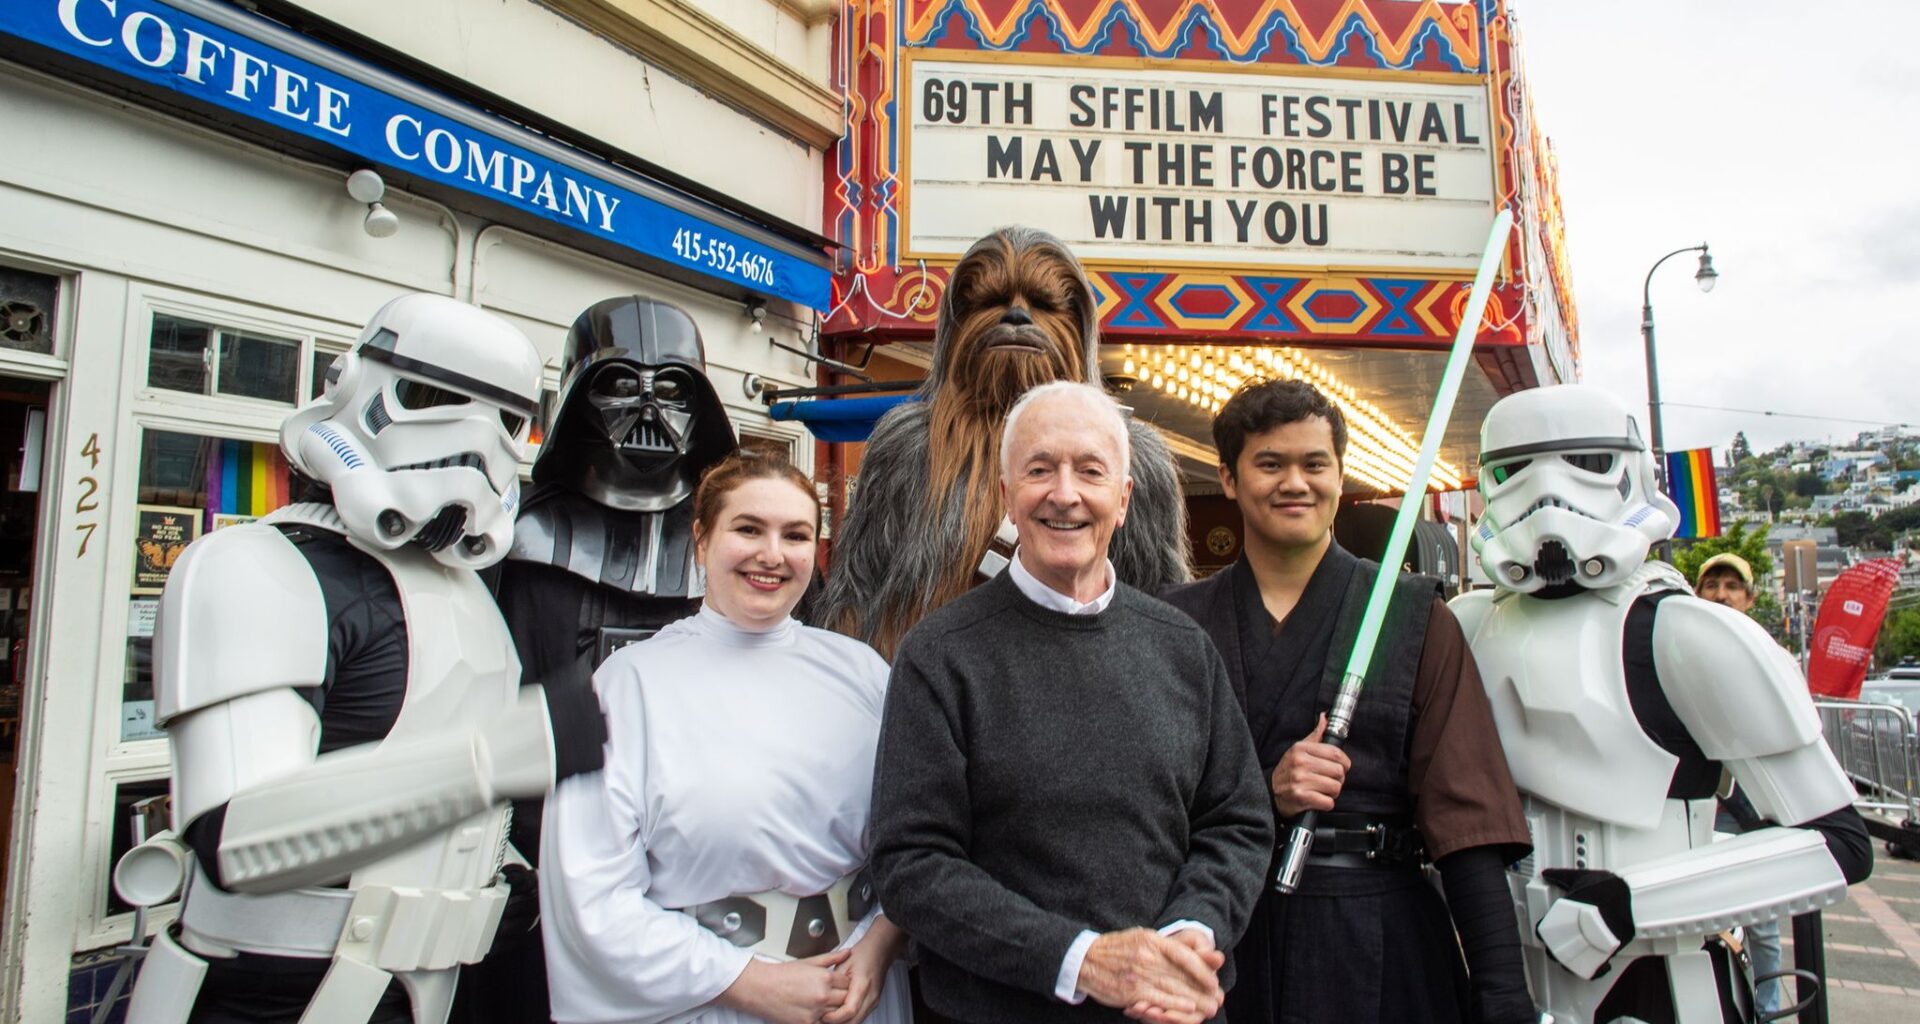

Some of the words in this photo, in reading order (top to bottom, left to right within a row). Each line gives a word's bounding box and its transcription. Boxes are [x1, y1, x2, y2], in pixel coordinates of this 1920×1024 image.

[58, 0, 352, 137] COFFEE
[385, 114, 621, 233] COMPANY
[922, 78, 1034, 126] 69TH
[1069, 85, 1224, 134] SFFILM
[1261, 94, 1480, 144] FESTIVAL
[986, 135, 1101, 183] MAY
[1124, 142, 1214, 187] THE
[1230, 145, 1364, 194] FORCE
[1382, 153, 1437, 196] BE
[1088, 195, 1213, 243] WITH
[1225, 200, 1329, 246] YOU
[671, 227, 774, 287] 415-552-6676
[76, 432, 101, 559] 427
